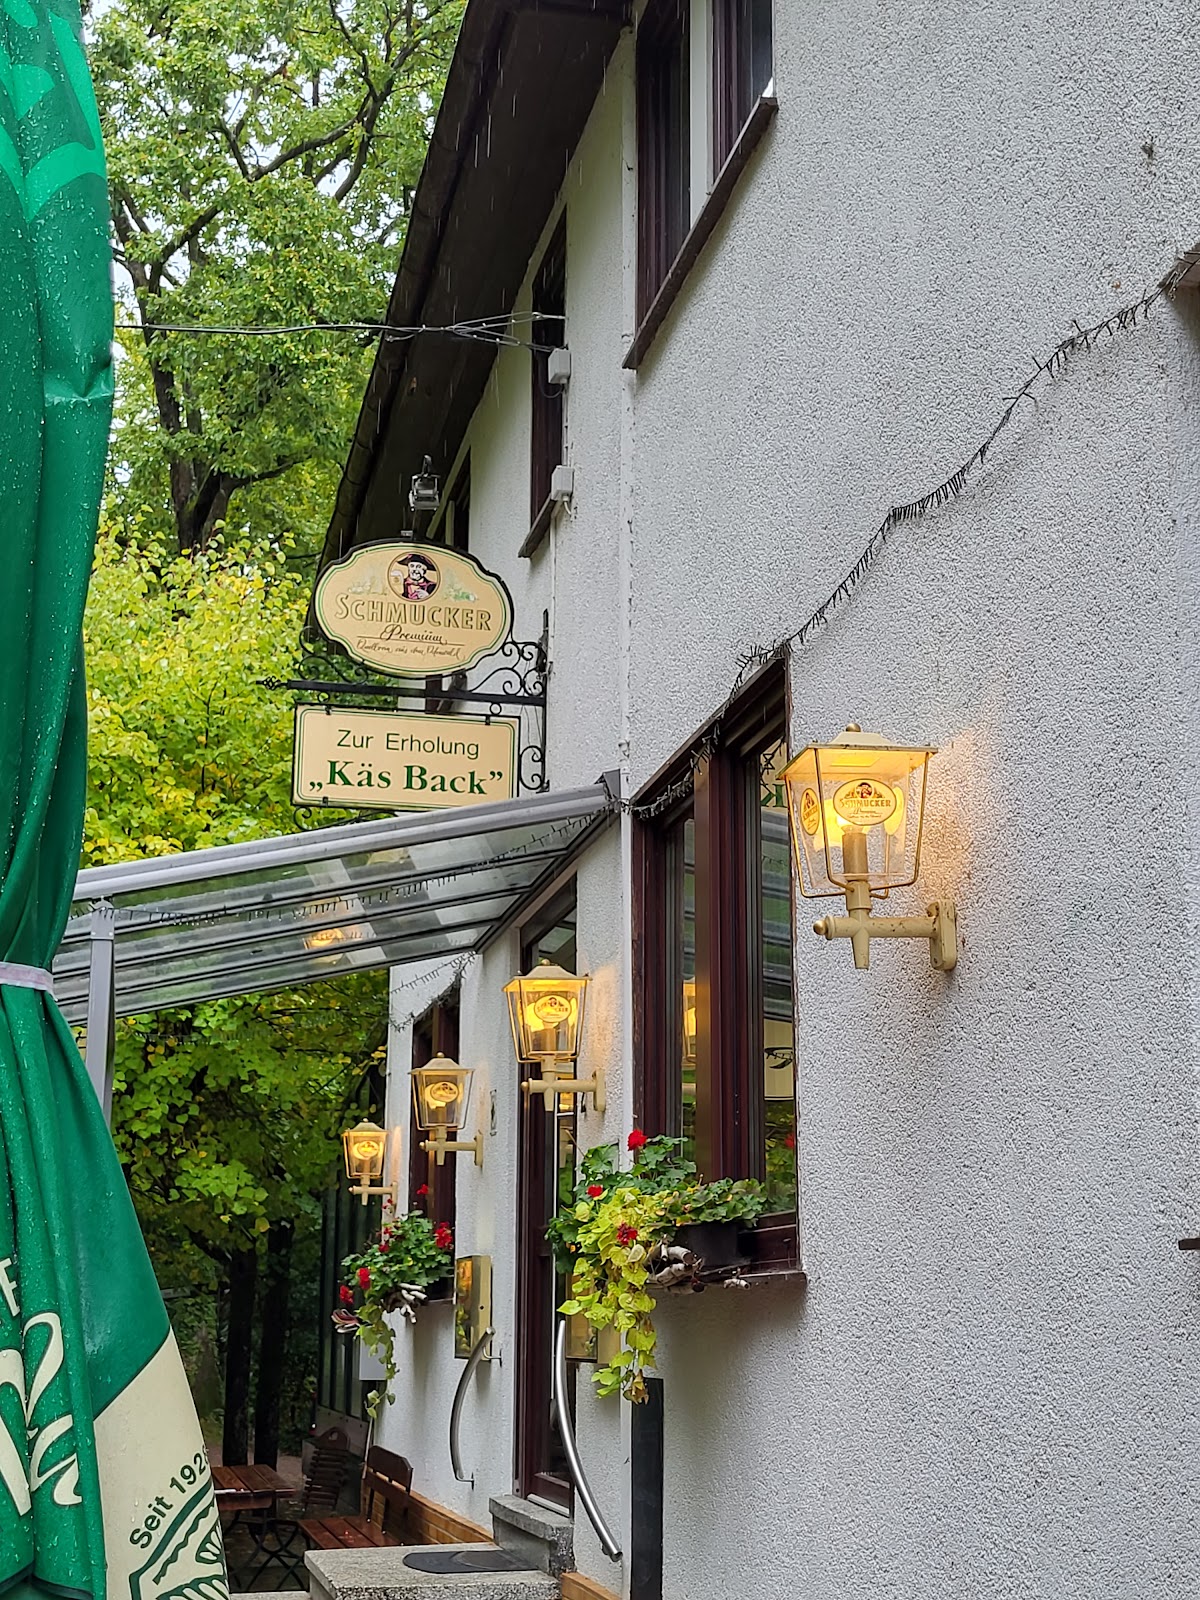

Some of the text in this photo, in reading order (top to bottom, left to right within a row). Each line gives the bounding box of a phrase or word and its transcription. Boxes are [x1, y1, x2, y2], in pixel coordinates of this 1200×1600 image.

[335, 593, 492, 631] SCHMUCKER
[336, 728, 480, 760] Zur Erholung
[839, 798, 892, 808] SCHMUCKER
[129, 1496, 174, 1549] Seit
